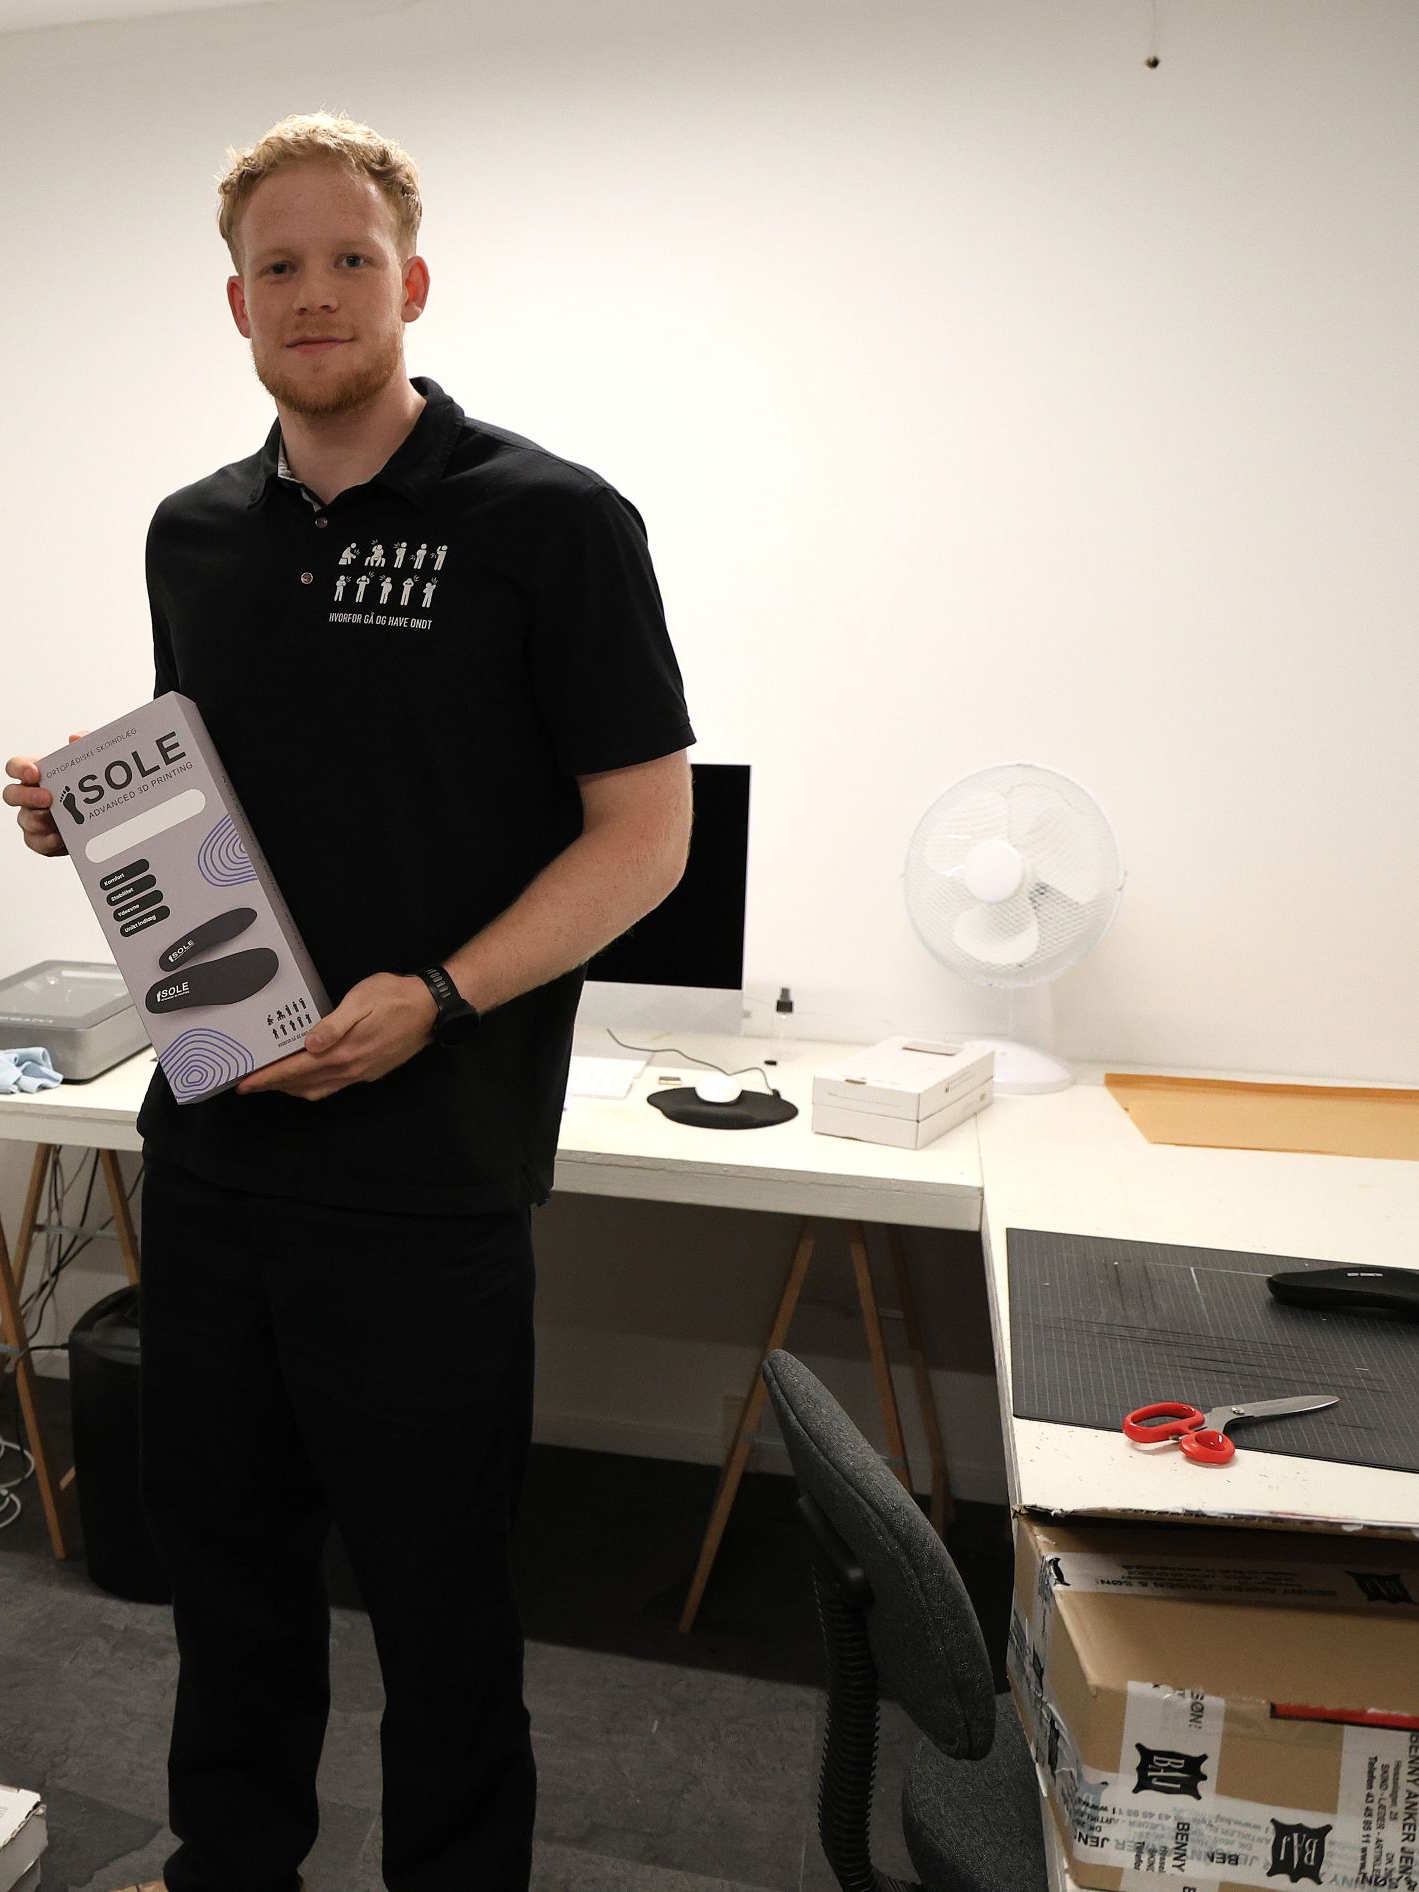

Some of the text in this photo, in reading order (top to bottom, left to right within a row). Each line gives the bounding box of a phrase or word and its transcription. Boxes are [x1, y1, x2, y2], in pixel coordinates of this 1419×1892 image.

[329, 611, 433, 630] HVORFOR GÅ OG HAVE ONDT
[96, 728, 138, 753] SKOINDLÆG
[89, 761, 194, 820] ADVANCED 3D PRINTING
[103, 873, 125, 886] Komfort
[124, 923, 139, 933] Unikt
[1147, 1755, 1192, 1789] BAJ
[1366, 1756, 1378, 1790] Telefon
[1379, 1763, 1389, 1791] SKIND
[1376, 1798, 1386, 1830] LÆDER
[1401, 1789, 1419, 1843] ANKER
[1171, 1821, 1191, 1873] BENNY
[1279, 1832, 1320, 1871] BAJ
